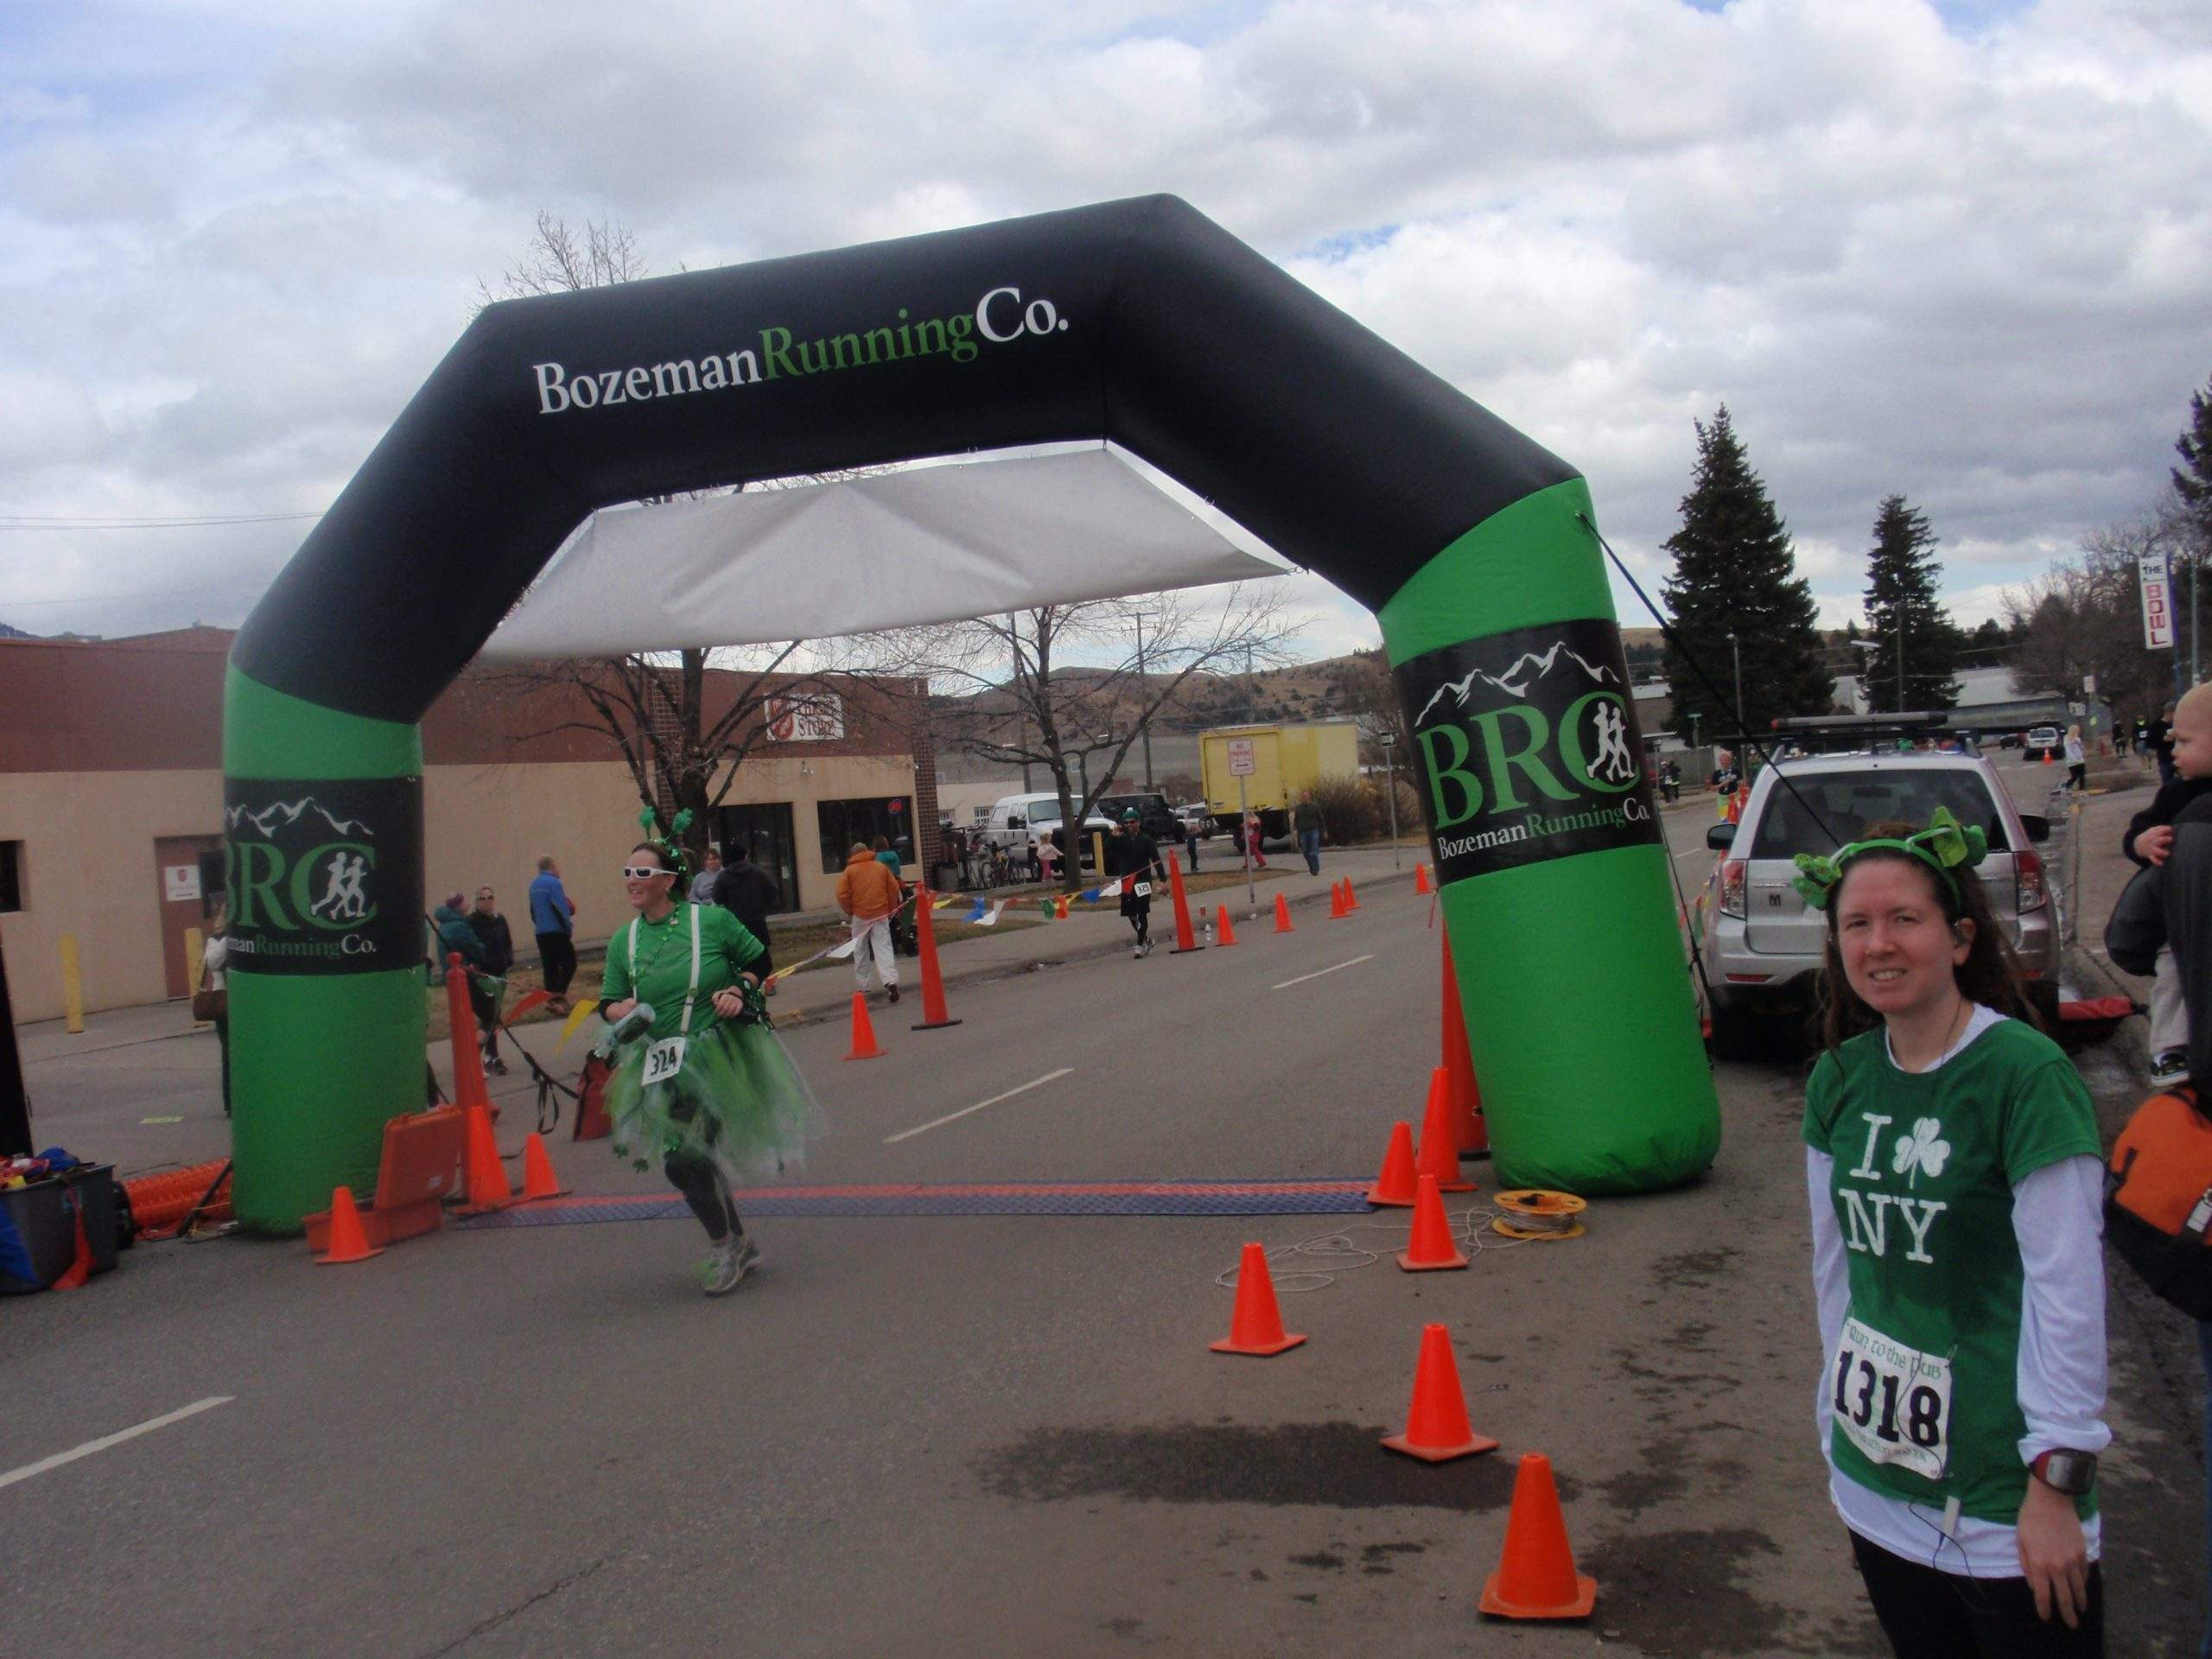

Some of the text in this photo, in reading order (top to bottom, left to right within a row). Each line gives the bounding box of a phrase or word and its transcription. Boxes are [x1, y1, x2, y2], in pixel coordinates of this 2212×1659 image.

[2142, 564, 2163, 575] THE
[1416, 691, 1640, 830] BRC
[650, 1046, 677, 1077] 324
[1849, 1112, 1892, 1180] I
[1838, 1188, 1948, 1264] NY
[1871, 1340, 1885, 1357] to
[1886, 1346, 1907, 1369] the
[1834, 1350, 1942, 1447] 1318
